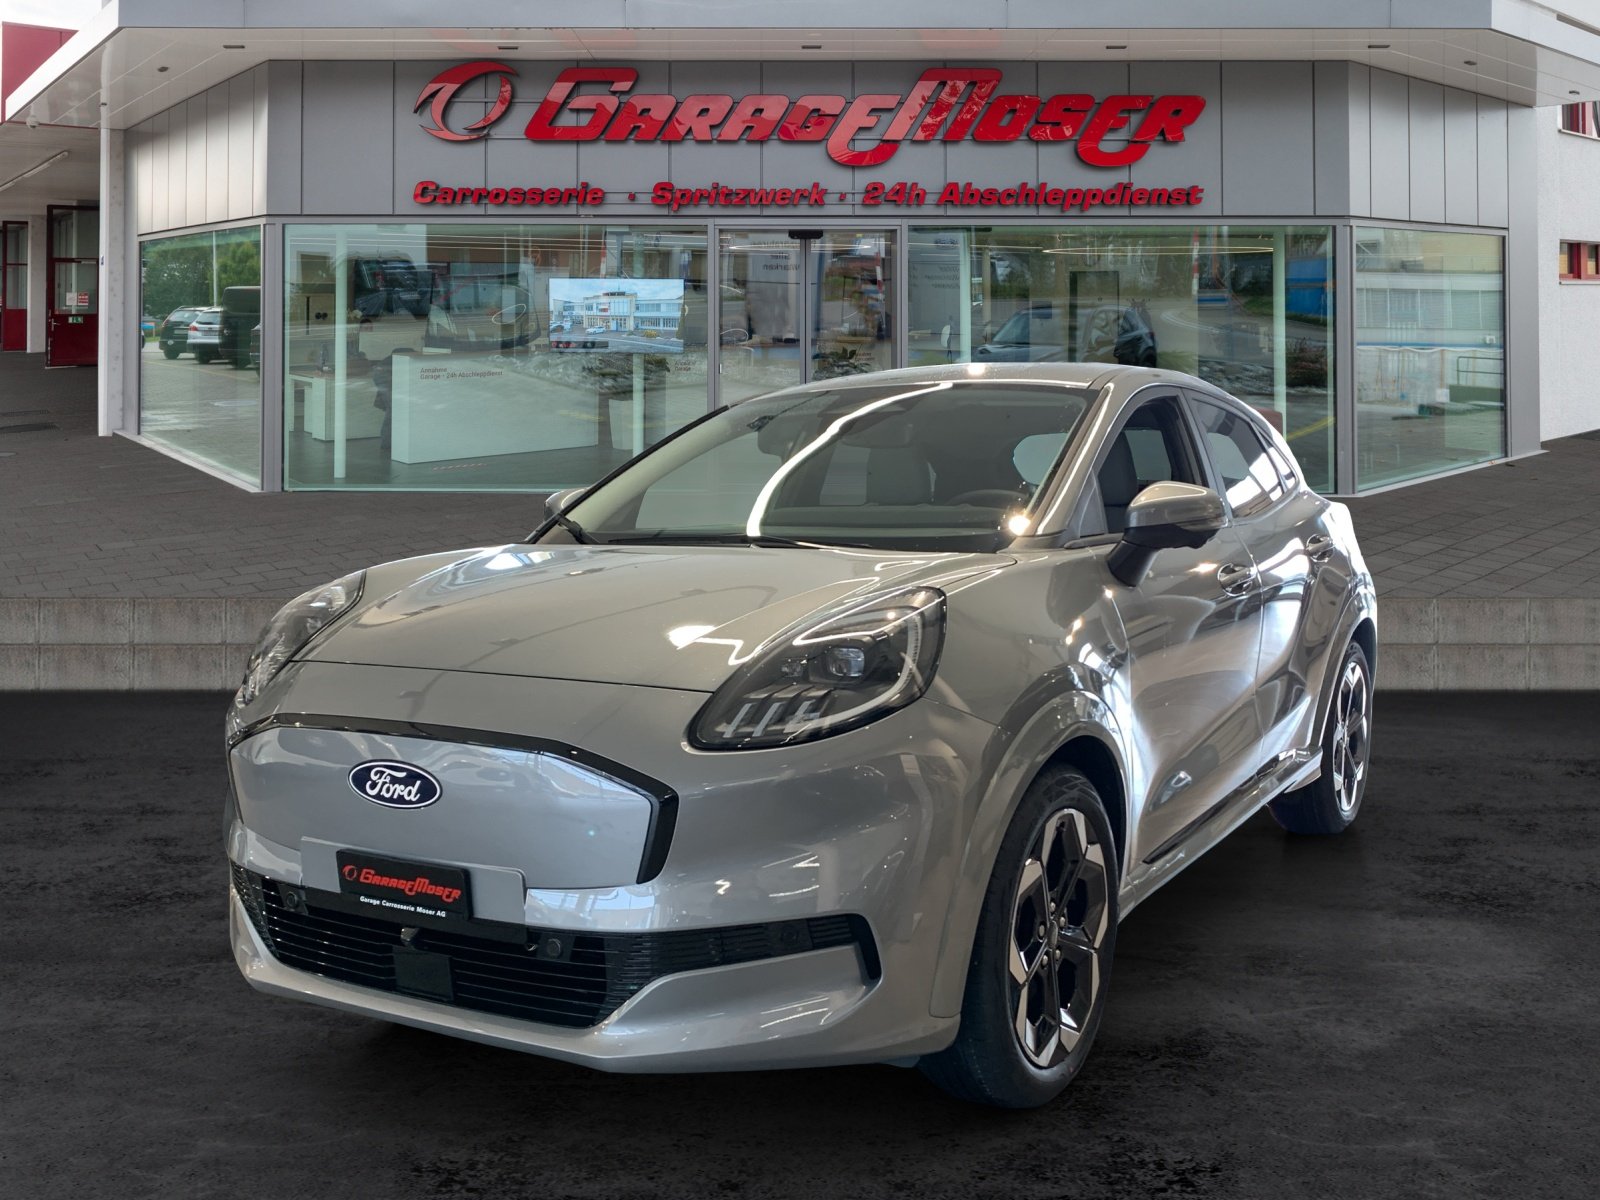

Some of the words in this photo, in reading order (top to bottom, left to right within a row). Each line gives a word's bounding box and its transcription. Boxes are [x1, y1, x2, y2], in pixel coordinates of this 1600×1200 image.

[413, 181, 605, 206] Carrosserie
[651, 182, 826, 212] Spritzwerk
[861, 182, 926, 206] 24h
[937, 182, 1204, 212] Abschleppdienst
[365, 767, 422, 801] Ford
[359, 896, 380, 905] Garage
[381, 900, 415, 911] Carrosserie
[416, 906, 435, 915] Moser
